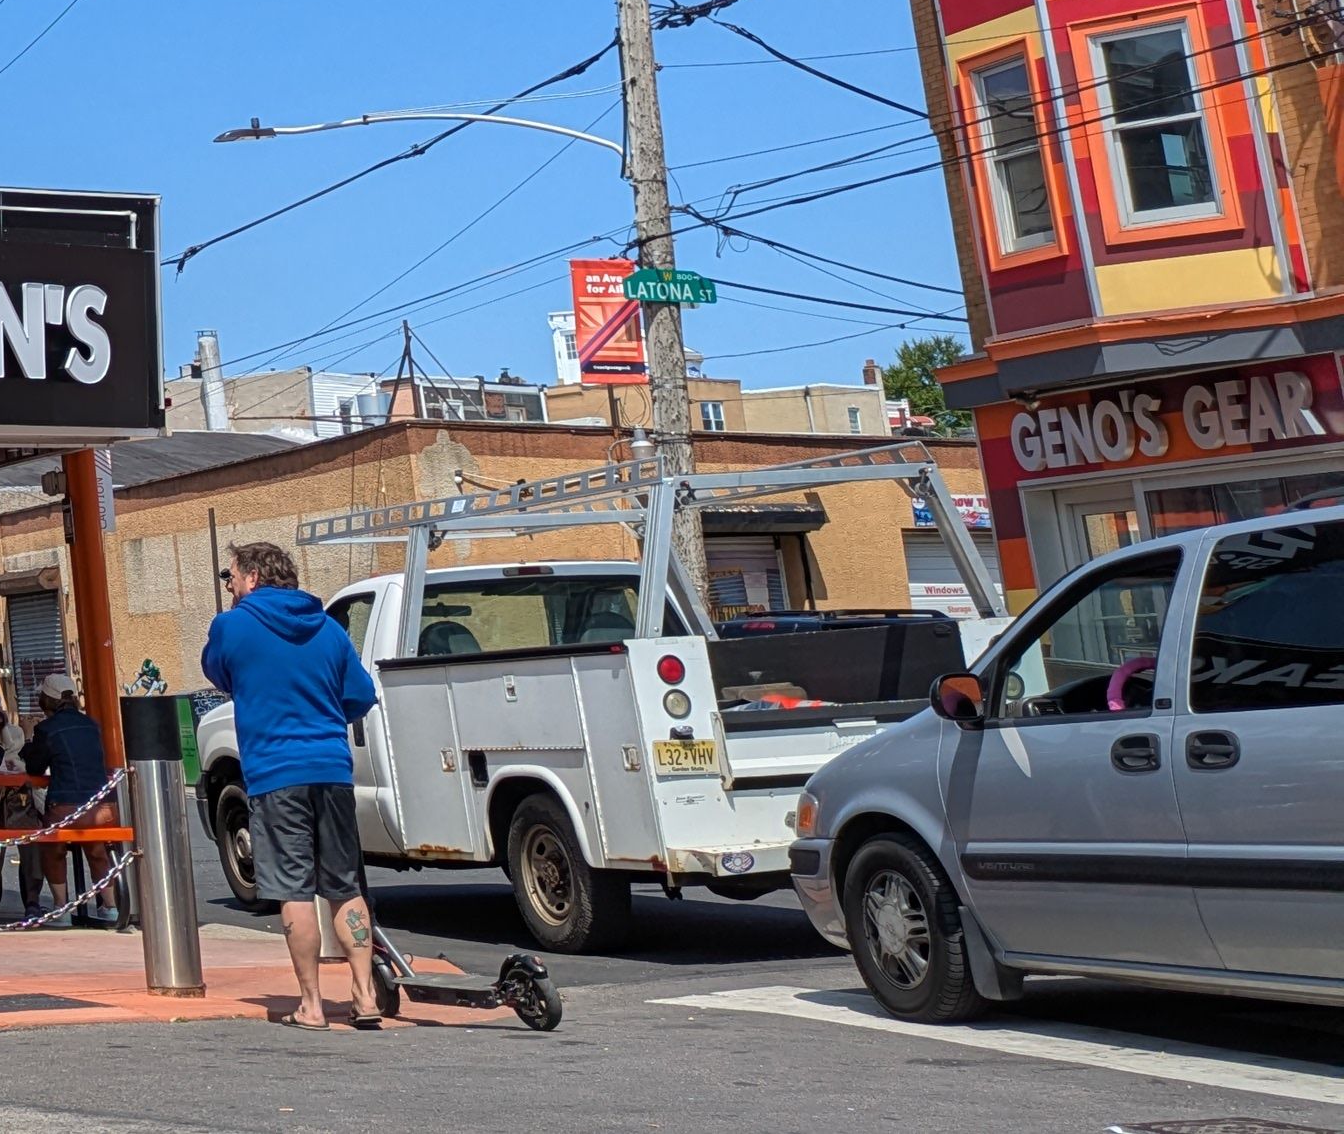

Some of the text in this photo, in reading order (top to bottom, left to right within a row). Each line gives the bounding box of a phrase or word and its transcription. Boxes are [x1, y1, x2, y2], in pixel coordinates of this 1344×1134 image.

[585, 275, 605, 283] an
[586, 284, 606, 294] for
[627, 281, 713, 302] LATONA ST
[1011, 371, 1327, 472] GENO'S GEAR
[924, 586, 964, 595] Windows
[947, 606, 972, 614] Storage
[658, 747, 714, 765] L32 VHV
